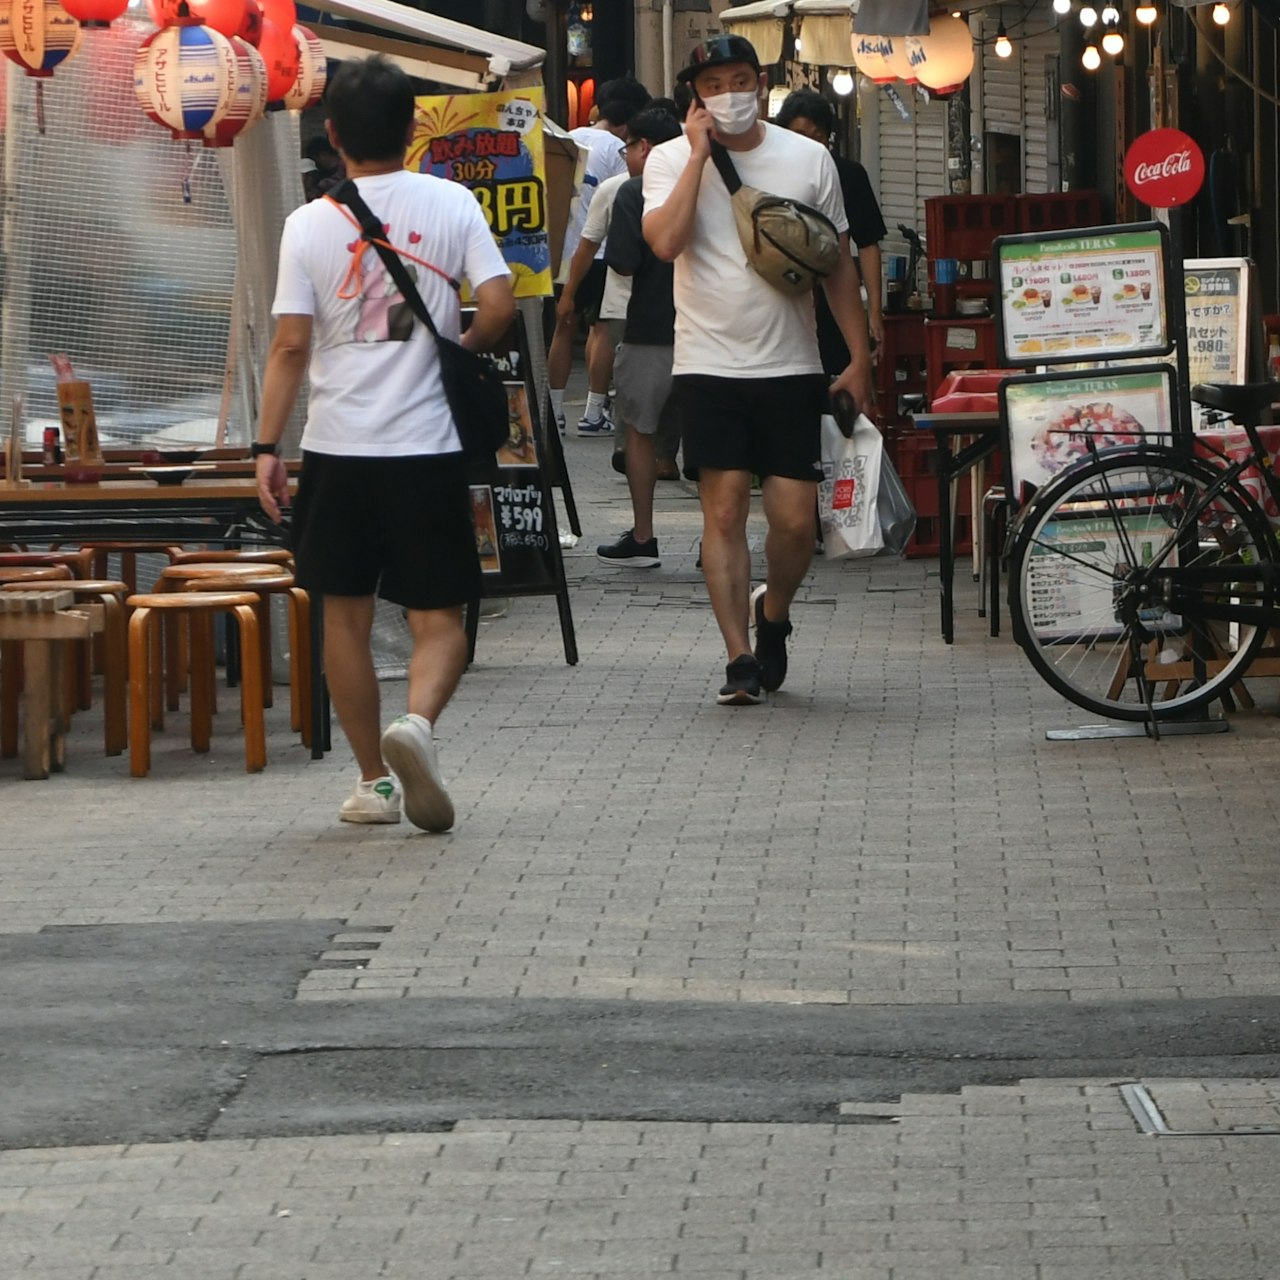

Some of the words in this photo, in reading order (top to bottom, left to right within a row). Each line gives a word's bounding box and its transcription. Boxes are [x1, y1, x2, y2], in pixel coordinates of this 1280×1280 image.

[154, 48, 172, 112] アサヒビール
[430, 131, 520, 163] 飲み放題
[453, 160, 495, 181] 30分
[1079, 238, 1117, 249] TERAS
